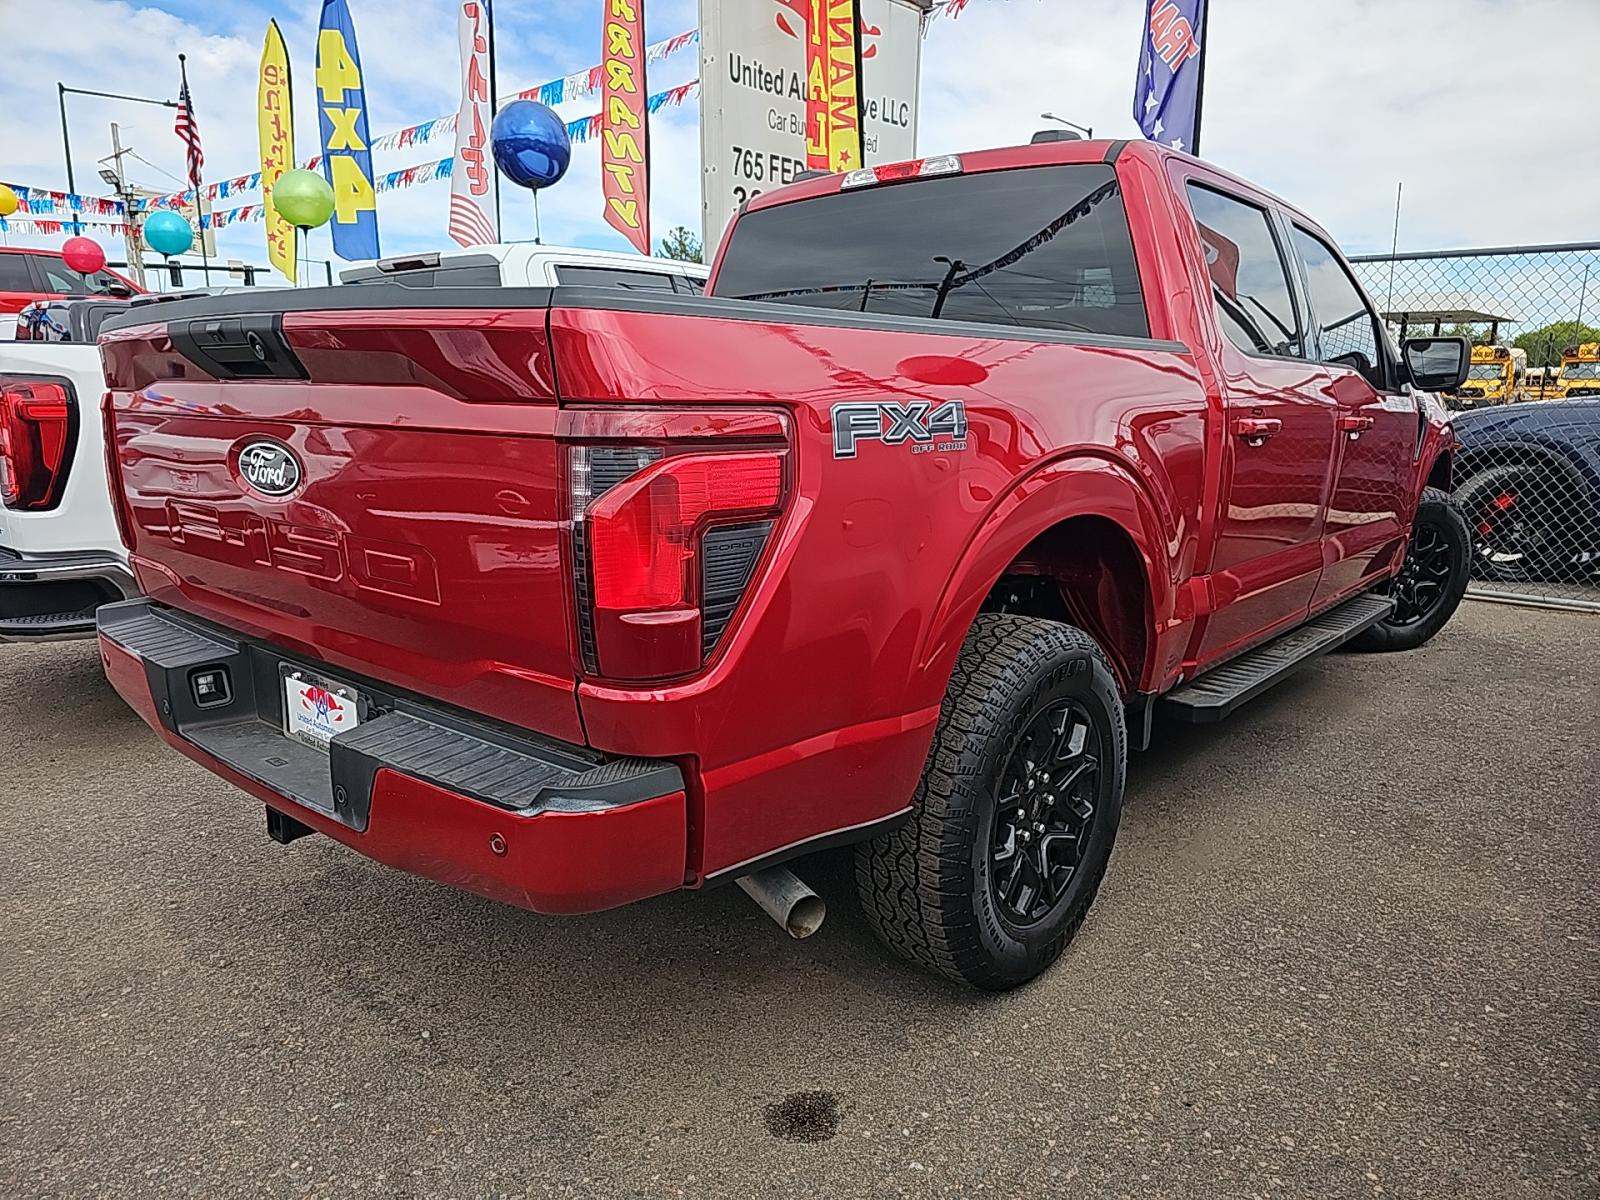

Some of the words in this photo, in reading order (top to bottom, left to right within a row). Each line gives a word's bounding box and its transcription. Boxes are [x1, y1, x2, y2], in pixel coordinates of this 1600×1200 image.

[729, 52, 784, 97] United
[882, 97, 909, 128] LLC
[768, 108, 787, 132] Car
[732, 146, 764, 182] 765
[831, 400, 968, 459] FX4
[912, 444, 935, 454] OFF
[938, 442, 967, 452] ROAD
[248, 449, 287, 486] Ford
[706, 541, 753, 553] FORD
